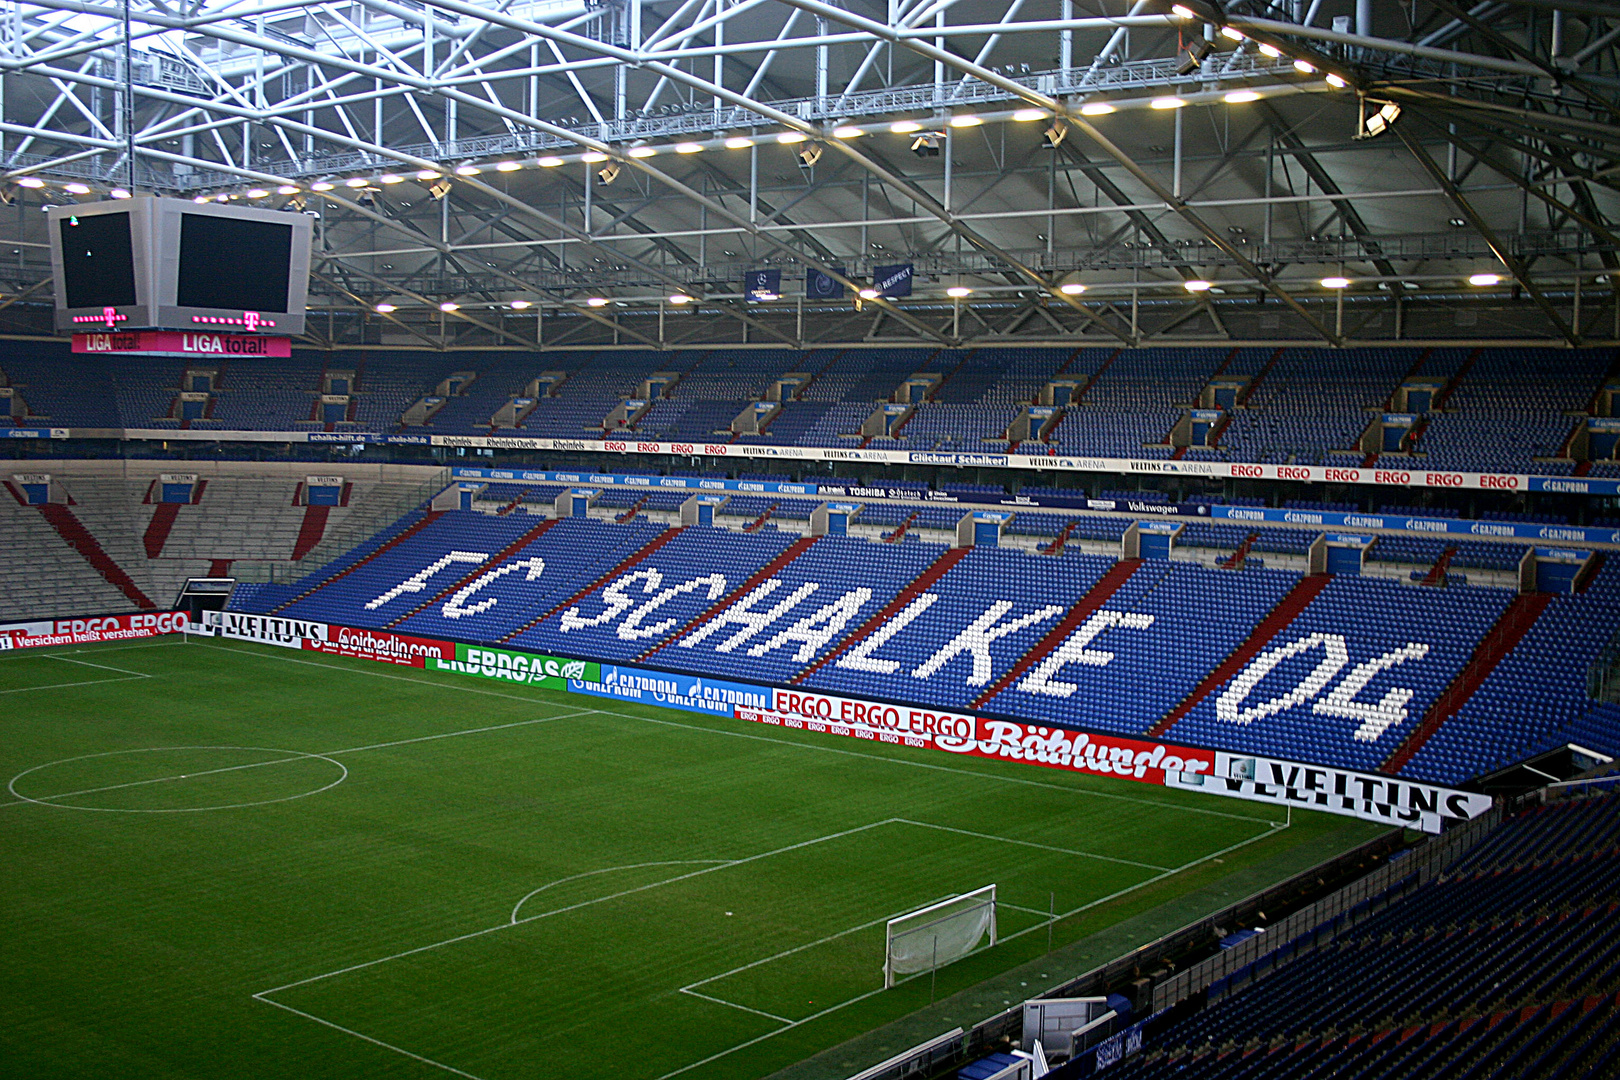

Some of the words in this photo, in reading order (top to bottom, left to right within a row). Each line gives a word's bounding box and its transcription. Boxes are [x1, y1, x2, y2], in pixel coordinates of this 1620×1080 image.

[881, 266, 912, 290] RESPECT
[103, 307, 117, 327] T
[243, 311, 260, 332] T
[86, 334, 111, 351] LIGA
[112, 335, 141, 350] total!
[182, 334, 223, 353] LIGA
[224, 337, 267, 354] total!
[310, 434, 366, 442] schalke-hilft.de
[387, 436, 427, 444] schalke-hilft.de
[443, 437, 472, 446] Rheinfels
[486, 438, 516, 448] Rheinfels
[516, 439, 538, 448] Quelle
[552, 440, 585, 450] Rheinfels
[604, 442, 626, 451] ERGO
[637, 443, 660, 452] ERGO
[671, 444, 694, 453] ERGO
[704, 445, 727, 455] ERGO
[742, 447, 766, 455] VELTINS
[779, 448, 803, 457] ARENA
[823, 449, 848, 458] VELTINS
[863, 451, 888, 460] ARENA
[911, 452, 957, 464] Glückauf
[1029, 457, 1058, 467] VELTINS
[1076, 459, 1106, 469] ARENA
[1130, 461, 1162, 471] VELTINS
[1181, 463, 1213, 473] ARENA
[1230, 465, 1263, 477] ERGO
[1276, 467, 1310, 479] ERGO
[1325, 469, 1360, 482] ERGO
[1374, 471, 1411, 484] ERGO
[1426, 473, 1463, 486] ERGO
[1479, 475, 1519, 489] ERGO
[849, 487, 886, 498] TOSHIBA
[1551, 481, 1589, 493] GAZPROM
[1127, 501, 1178, 515] Volkswagen
[1235, 508, 1264, 520] GAZPROM
[1291, 511, 1322, 524] GAZPROM
[1351, 516, 1384, 528] GAZPROM
[1413, 520, 1448, 532] GAZPROM
[1479, 524, 1515, 537] GAZPROM
[1547, 528, 1586, 541] GAZPROM
[130, 612, 189, 633] ERGO
[16, 635, 72, 648] Versichern
[73, 630, 101, 642] heißt
[103, 627, 153, 640] verstehen.
[364, 550, 545, 619] FC
[559, 566, 1155, 699] SCHALKE
[1216, 632, 1430, 744] 04
[776, 691, 832, 720] ERGO
[740, 711, 758, 722] ERGO
[841, 699, 900, 727] ERGO
[762, 715, 780, 725] ERGO
[785, 718, 803, 729] ERGO
[909, 710, 971, 739] ERGO
[807, 722, 827, 733] ERGO
[831, 725, 850, 736] ERGO
[855, 729, 875, 740] ERGO
[879, 732, 899, 744] ERGO
[904, 736, 925, 748] ERGO
